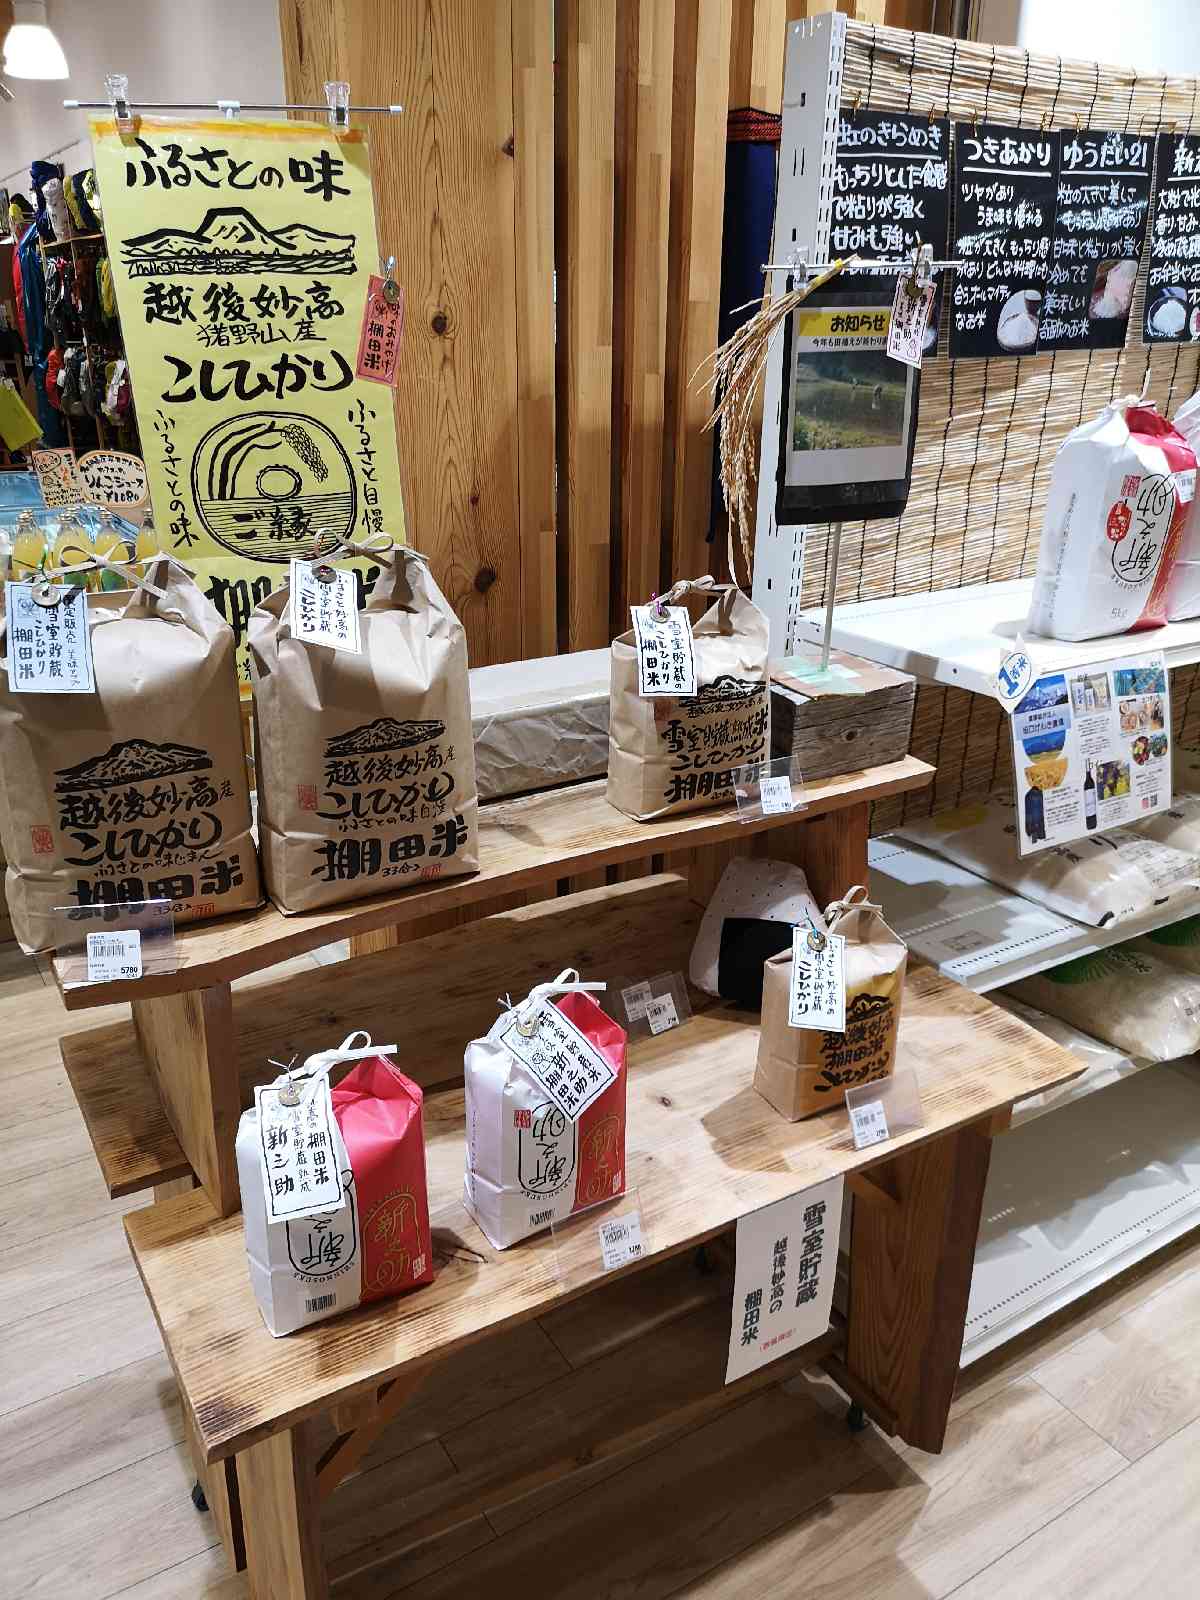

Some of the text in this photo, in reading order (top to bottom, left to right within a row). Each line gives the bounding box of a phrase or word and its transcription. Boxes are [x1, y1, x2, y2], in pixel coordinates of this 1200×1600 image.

[126, 137, 350, 201] ふるさとの味
[963, 136, 1051, 167] つきあかり
[1063, 139, 1148, 169] ゆうだい21
[961, 182, 1014, 202] ツヤがあり
[143, 281, 344, 325] 越後妙高
[830, 314, 886, 333] お知らせ
[197, 319, 327, 347] 猪野山産
[161, 350, 354, 403] こしひかり
[153, 410, 200, 548] ふるさとの味
[348, 399, 384, 534] ふるさと自慢
[233, 506, 316, 541] ご縁
[14, 627, 35, 680] 棚田米
[35, 620, 46, 674] こしひかり
[641, 638, 660, 687] 棚田米
[656, 631, 670, 684] こしひかり
[671, 738, 766, 771] こしひかり
[316, 772, 454, 819] こしひかり
[64, 811, 222, 866] こしひかり
[311, 815, 468, 881] 棚田米
[66, 855, 243, 921] 棚田米
[121, 966, 138, 974] 5780
[545, 1070, 580, 1110] 棚田米
[266, 1124, 295, 1196] 新之助
[769, 1234, 789, 1314] 越後妙高の
[795, 1201, 826, 1308] 雪室貯蔵
[741, 1288, 763, 1347] 棚田米
